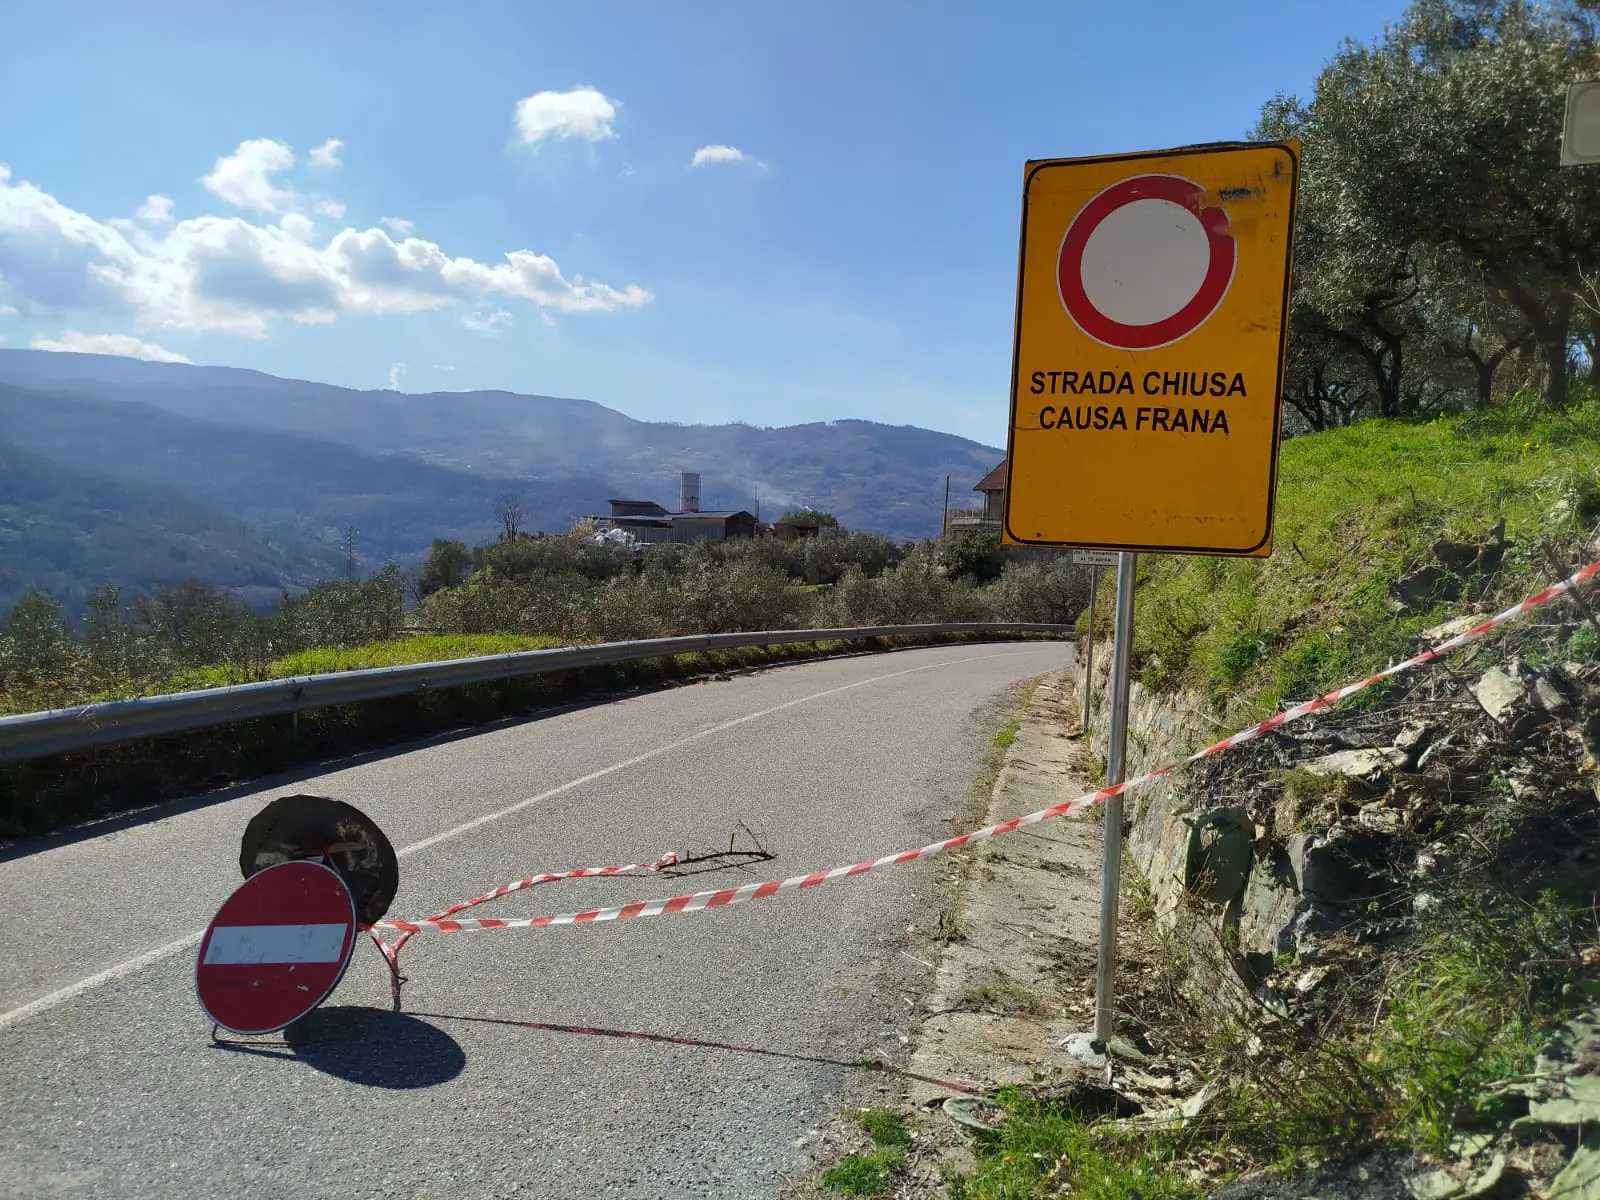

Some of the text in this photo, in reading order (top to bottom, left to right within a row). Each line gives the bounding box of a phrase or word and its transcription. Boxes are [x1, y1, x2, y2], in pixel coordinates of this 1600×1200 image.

[1030, 370, 1248, 398] STRADA CHIUSA
[1039, 406, 1230, 434] CAUSA FRANA
